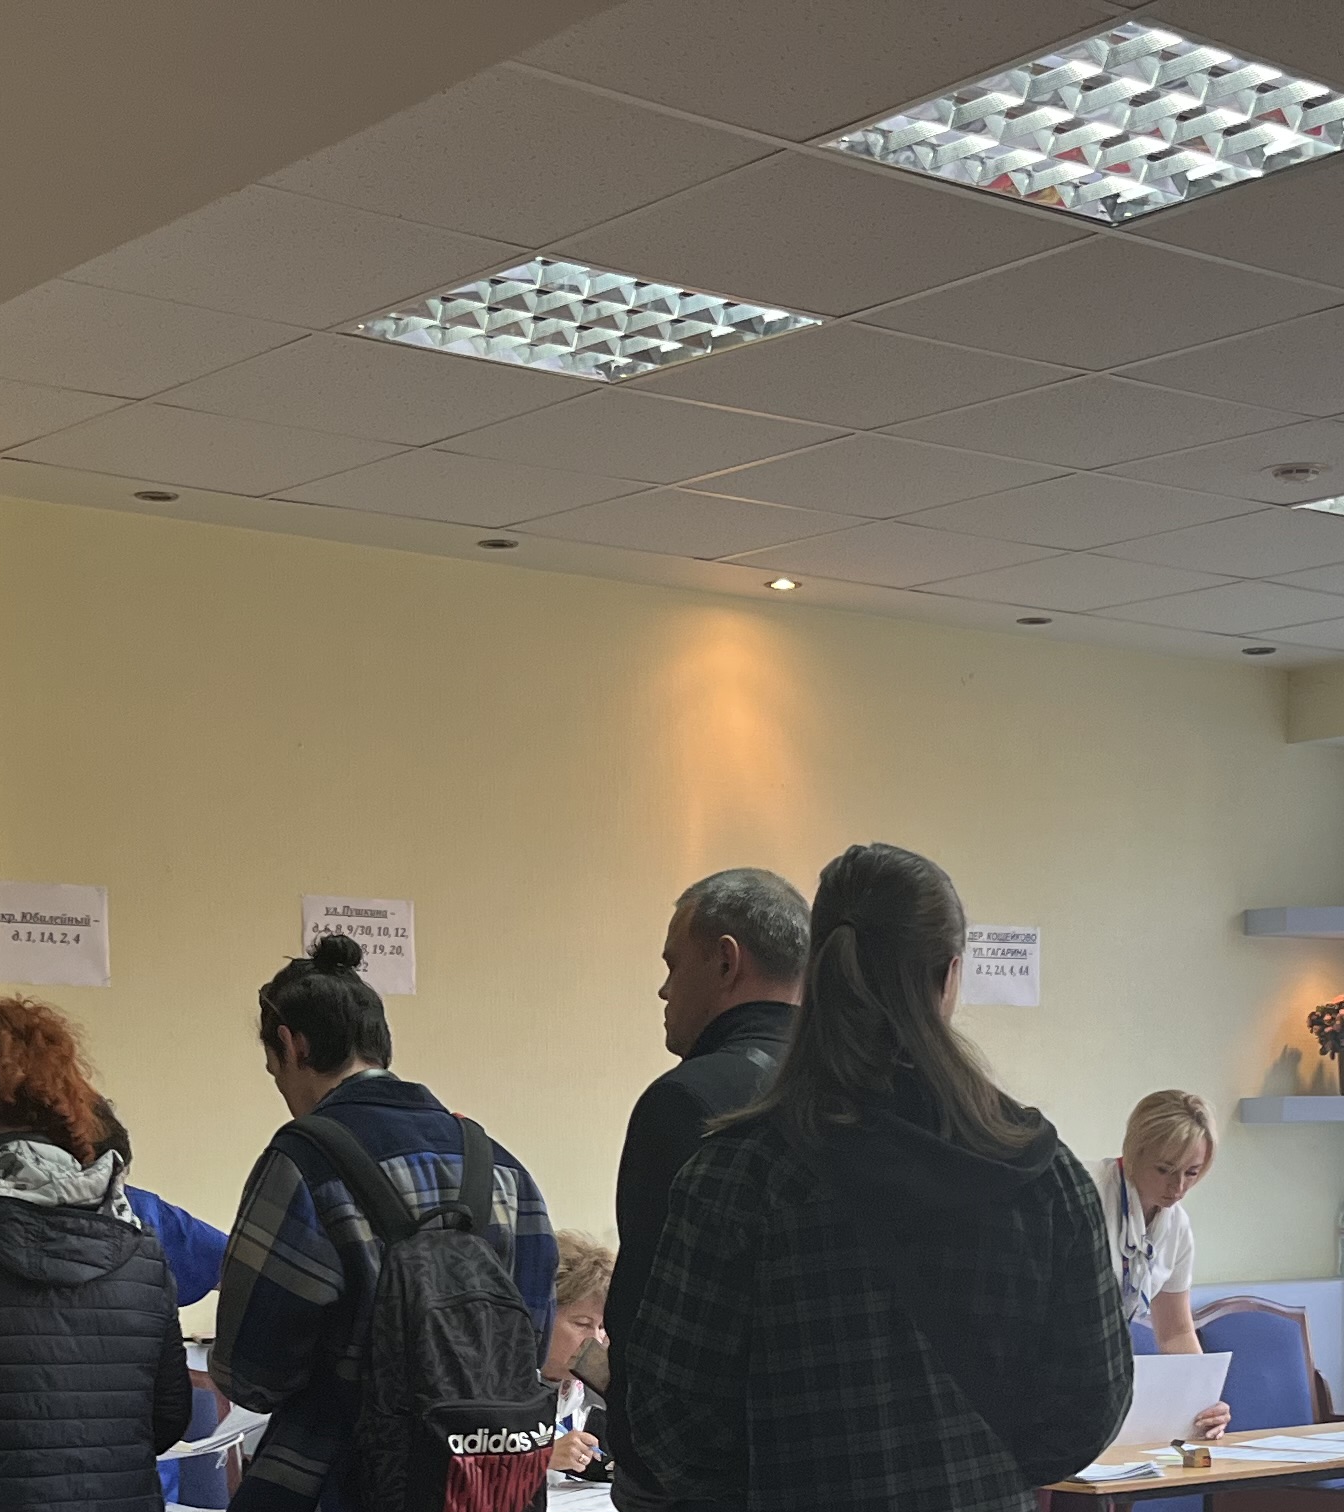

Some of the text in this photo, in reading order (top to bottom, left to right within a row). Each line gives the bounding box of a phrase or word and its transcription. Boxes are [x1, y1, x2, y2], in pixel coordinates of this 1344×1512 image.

[324, 906, 340, 916] ул.
[342, 905, 388, 918] Пушкина
[21, 911, 91, 927] Юбилейный
[11, 929, 22, 942] д.
[25, 931, 36, 943] 1,
[60, 933, 71, 945] 2,
[72, 933, 81, 945] 4
[347, 925, 374, 938] 9/30,
[377, 926, 391, 938] 10,
[394, 927, 409, 939] 12,
[372, 944, 387, 956] 19,
[389, 945, 405, 957] 20,
[986, 948, 1027, 958] ГАГАРИНА
[447, 1427, 532, 1455] adidas
